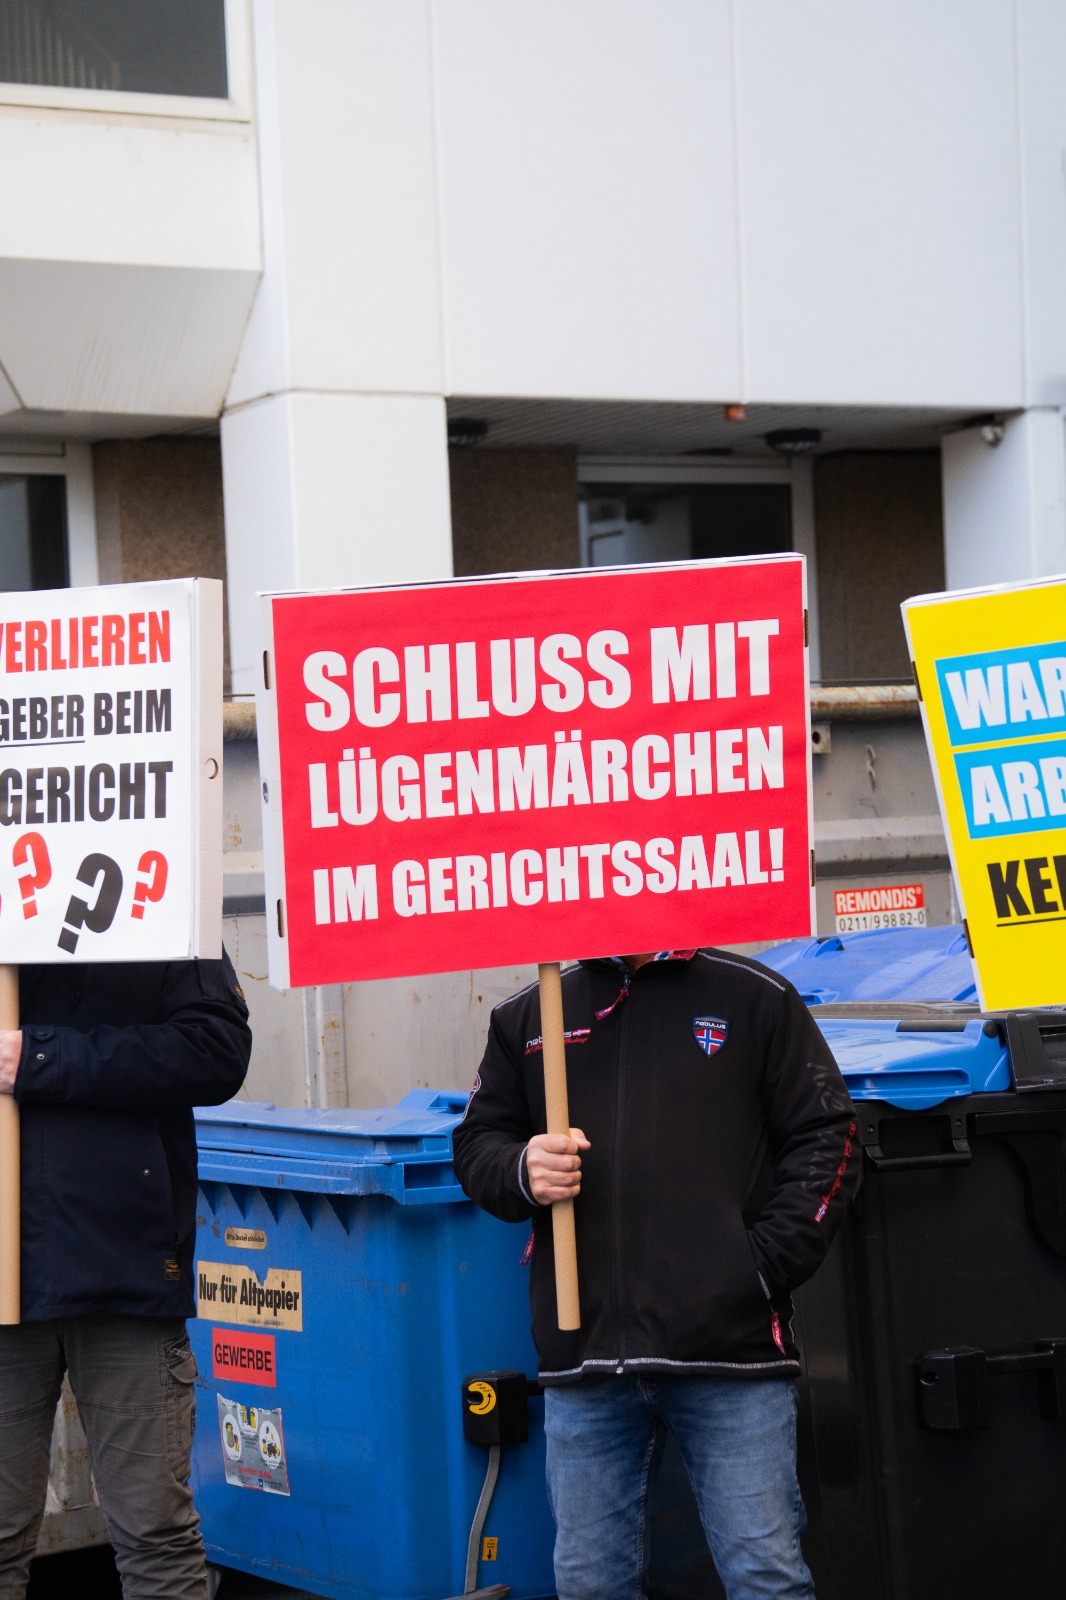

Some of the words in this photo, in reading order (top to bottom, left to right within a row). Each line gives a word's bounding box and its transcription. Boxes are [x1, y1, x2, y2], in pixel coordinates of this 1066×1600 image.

[0, 610, 171, 673] ERLIEREN
[302, 630, 632, 732] SCHLUSS
[650, 619, 780, 704] MIT
[93, 688, 172, 736] BEIM
[0, 761, 173, 826] GERICHT
[308, 725, 784, 829] LÜGENMÄRCHEN
[313, 864, 379, 925] IM
[392, 828, 784, 918] GERICHTSSAAL!
[199, 1273, 218, 1301] Nur
[220, 1274, 238, 1303] für
[240, 1278, 299, 1317] Altpapier
[215, 1343, 273, 1372] GEWERBE
